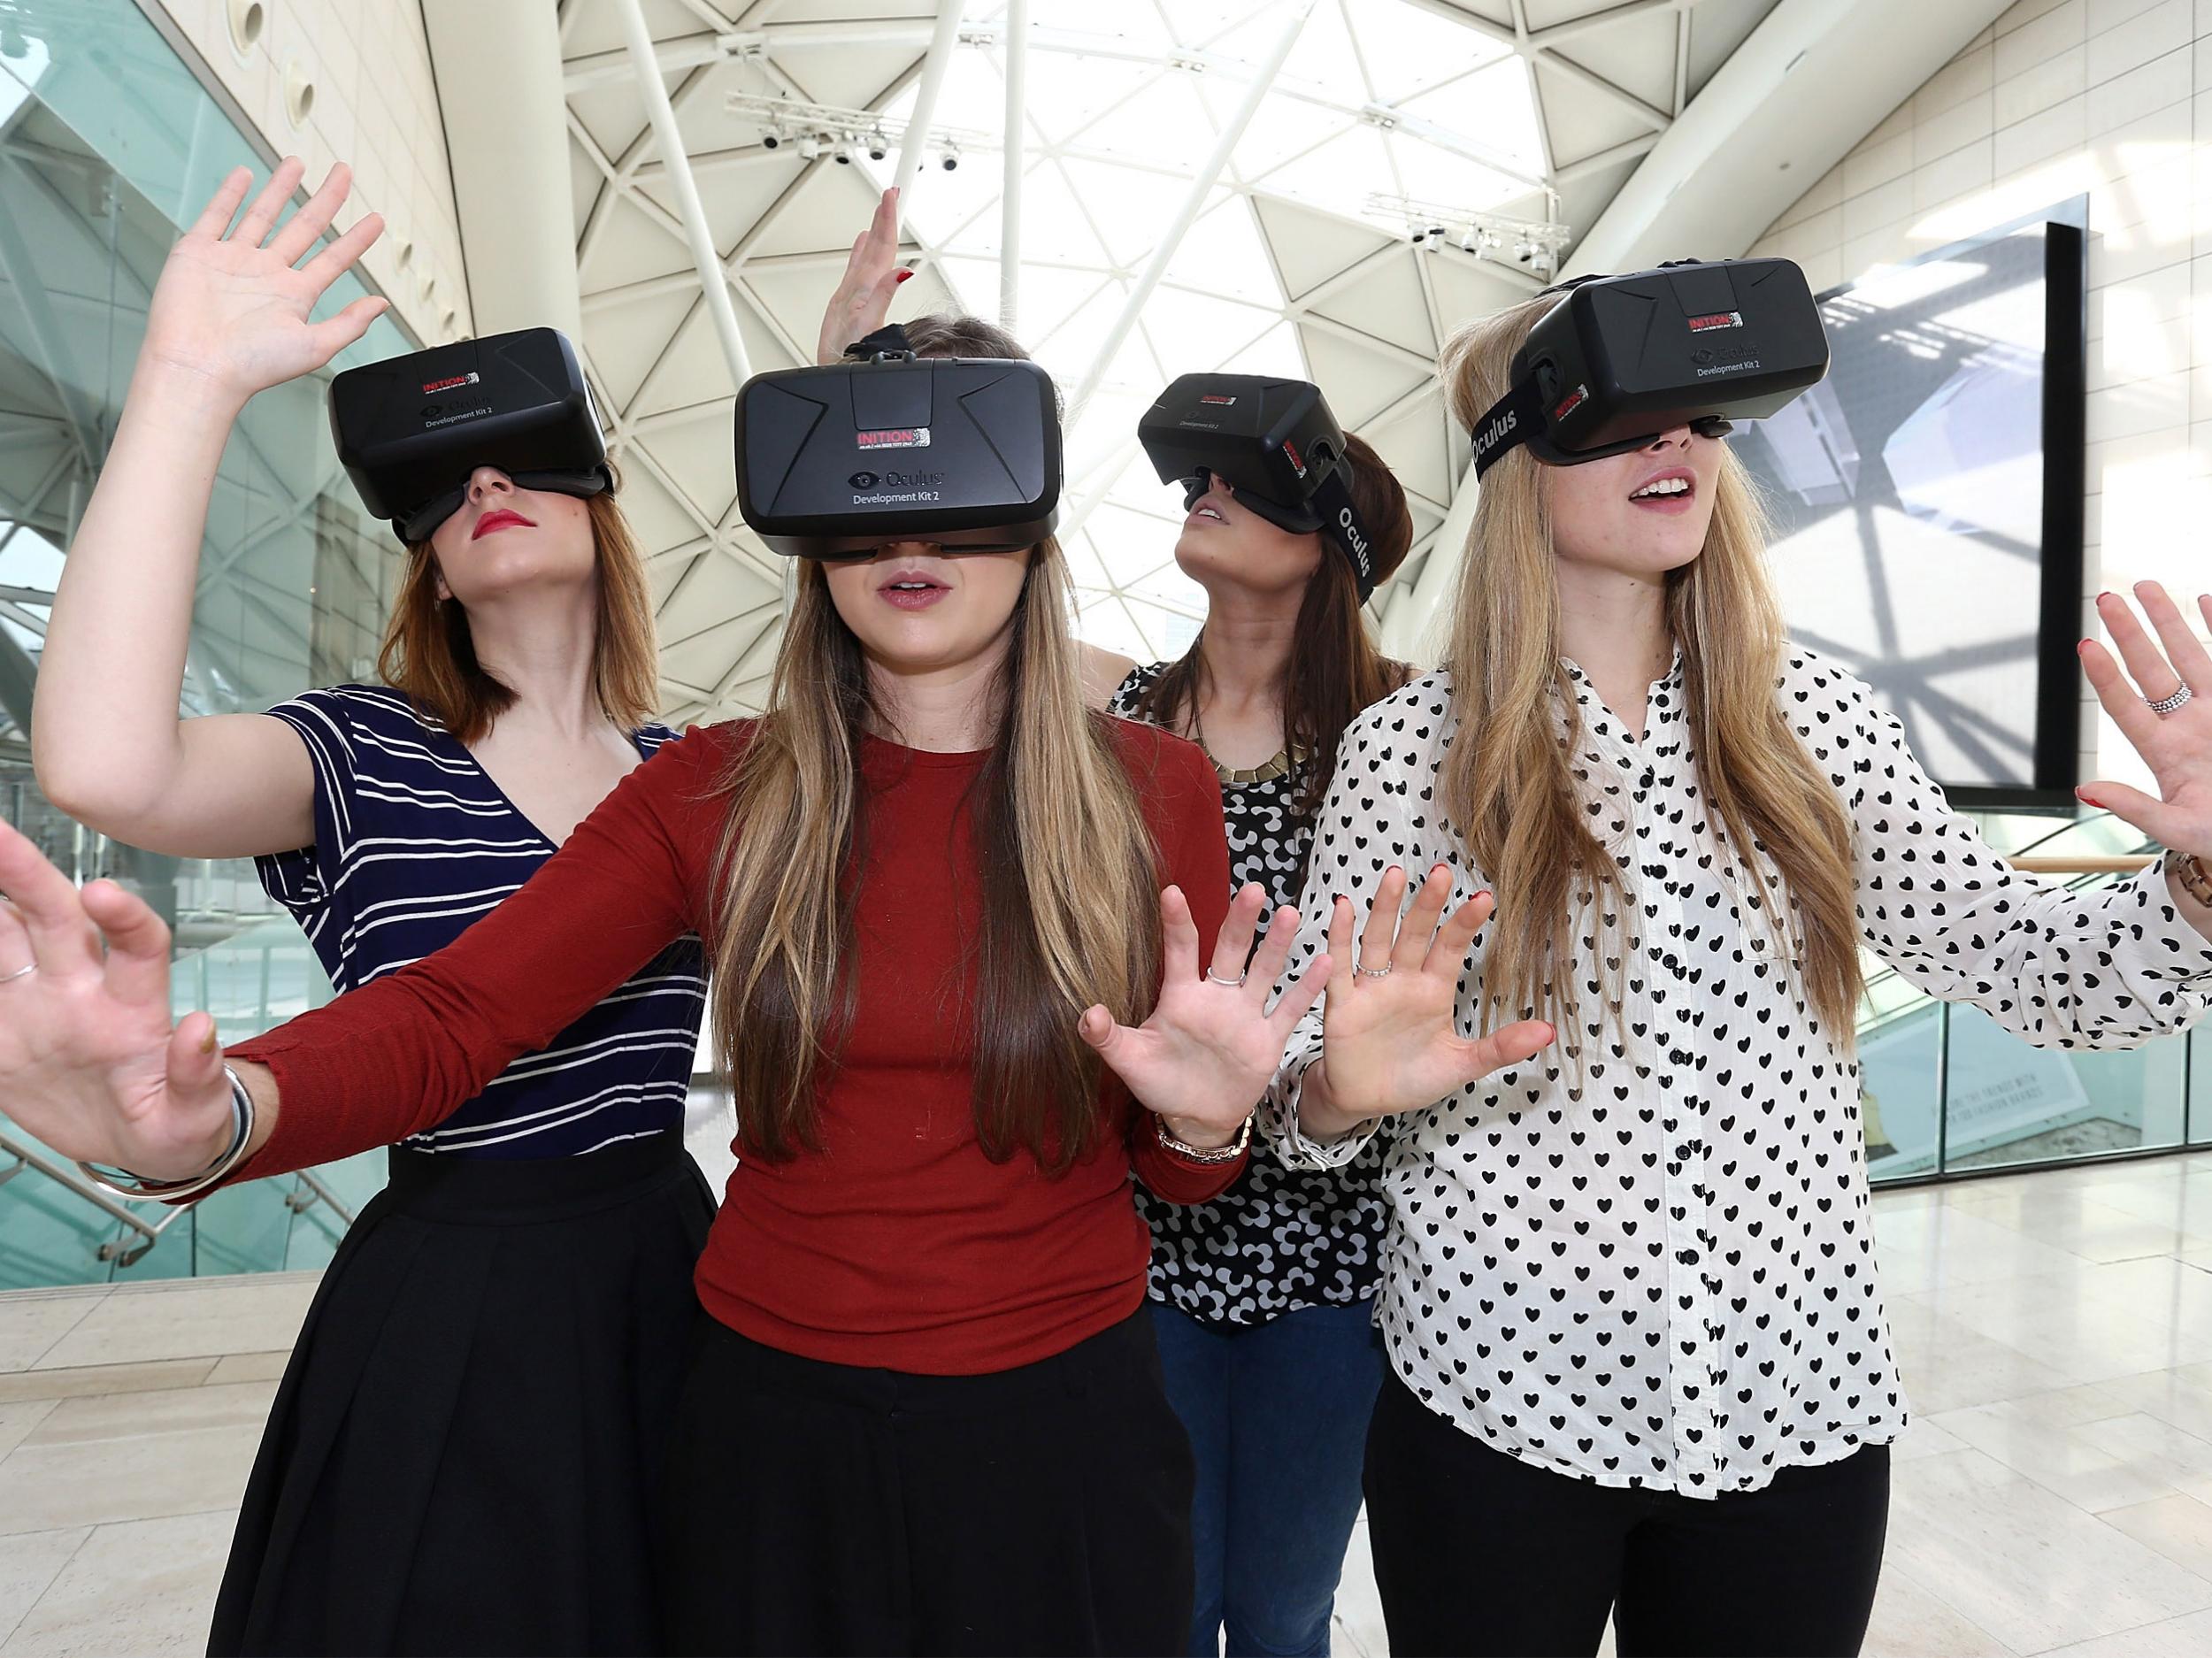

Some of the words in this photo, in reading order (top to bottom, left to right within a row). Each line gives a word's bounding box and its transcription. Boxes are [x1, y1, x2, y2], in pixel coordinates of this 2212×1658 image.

[1689, 314, 1730, 330] INITION
[1697, 364, 1744, 377] Development
[1744, 361, 1755, 370] Kit
[423, 375, 465, 392] INITION
[426, 410, 475, 428] Development
[475, 408, 487, 417] Kit
[856, 430, 913, 445] INITION
[1472, 410, 1517, 464] Oculus
[886, 469, 942, 487] Oculus
[853, 493, 917, 505] Development
[918, 491, 932, 502] Kit
[932, 491, 940, 502] 2
[1339, 507, 1372, 578] Oculus
